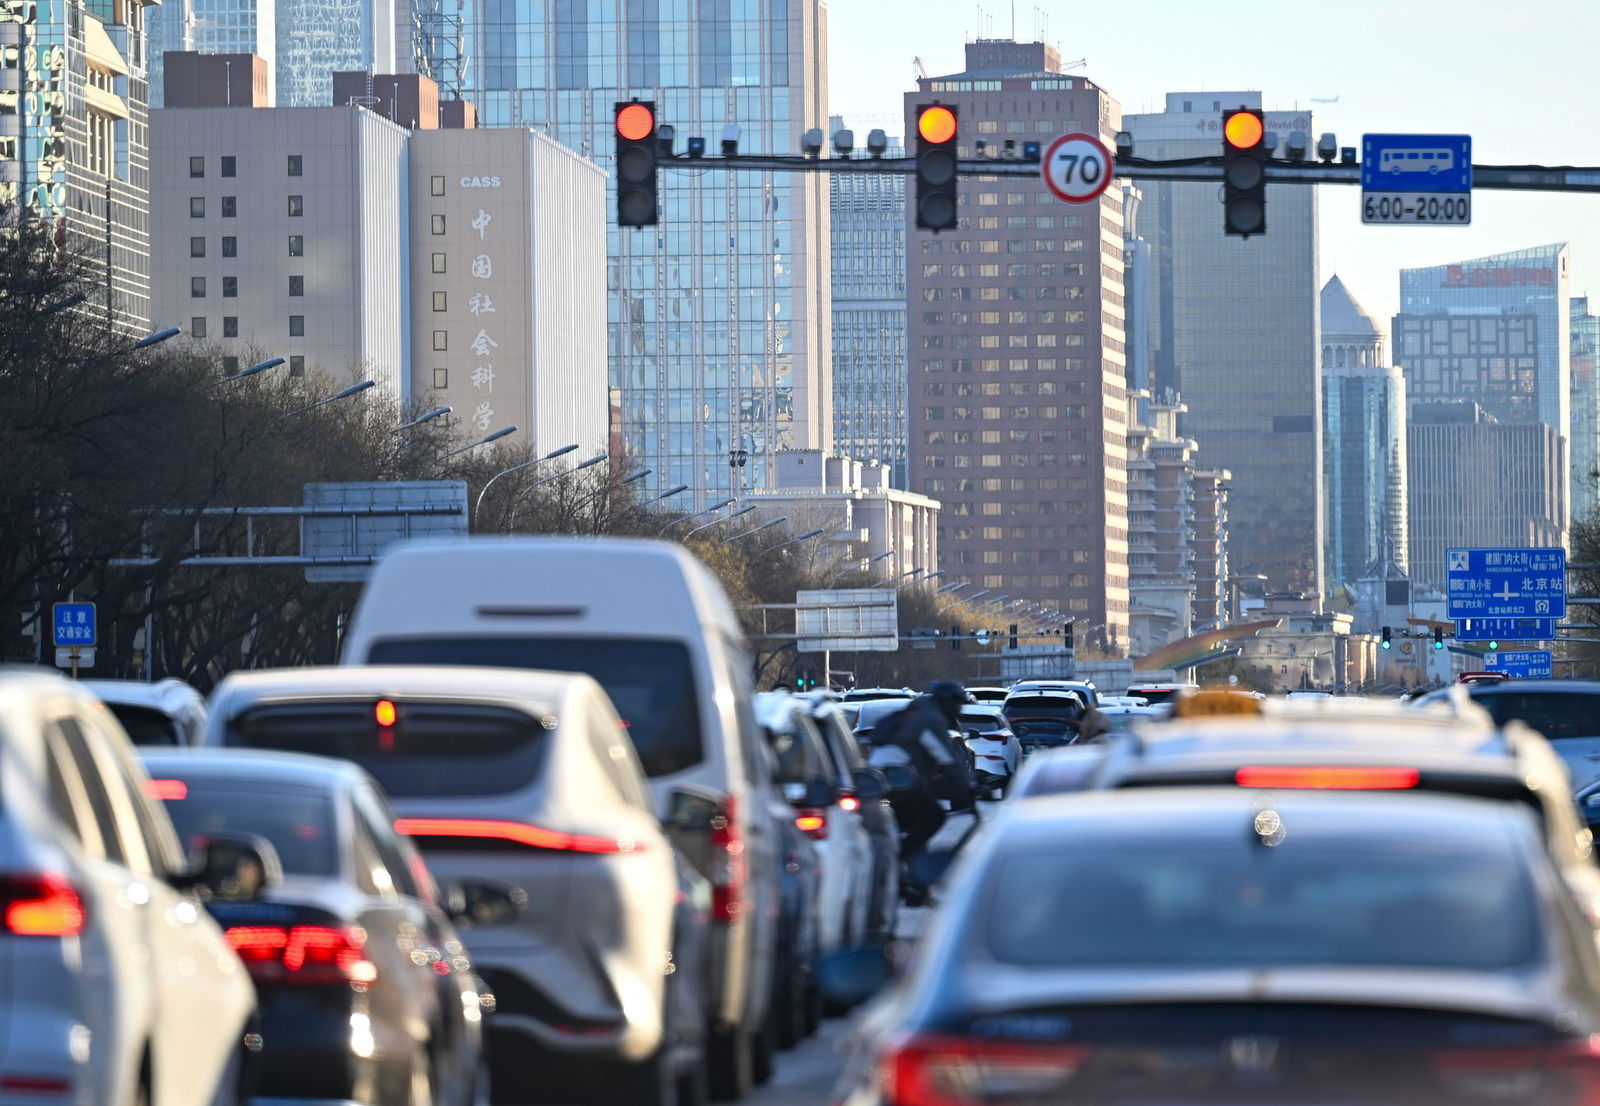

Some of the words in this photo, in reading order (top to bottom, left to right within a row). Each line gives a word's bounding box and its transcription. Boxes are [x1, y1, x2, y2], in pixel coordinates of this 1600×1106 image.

[1058, 154, 1100, 186] 70
[459, 176, 501, 188] CASS
[1364, 196, 1467, 220] 6:00-20:00
[1485, 552, 1528, 566] 建国门内大街
[1521, 577, 1563, 591] 北京站
